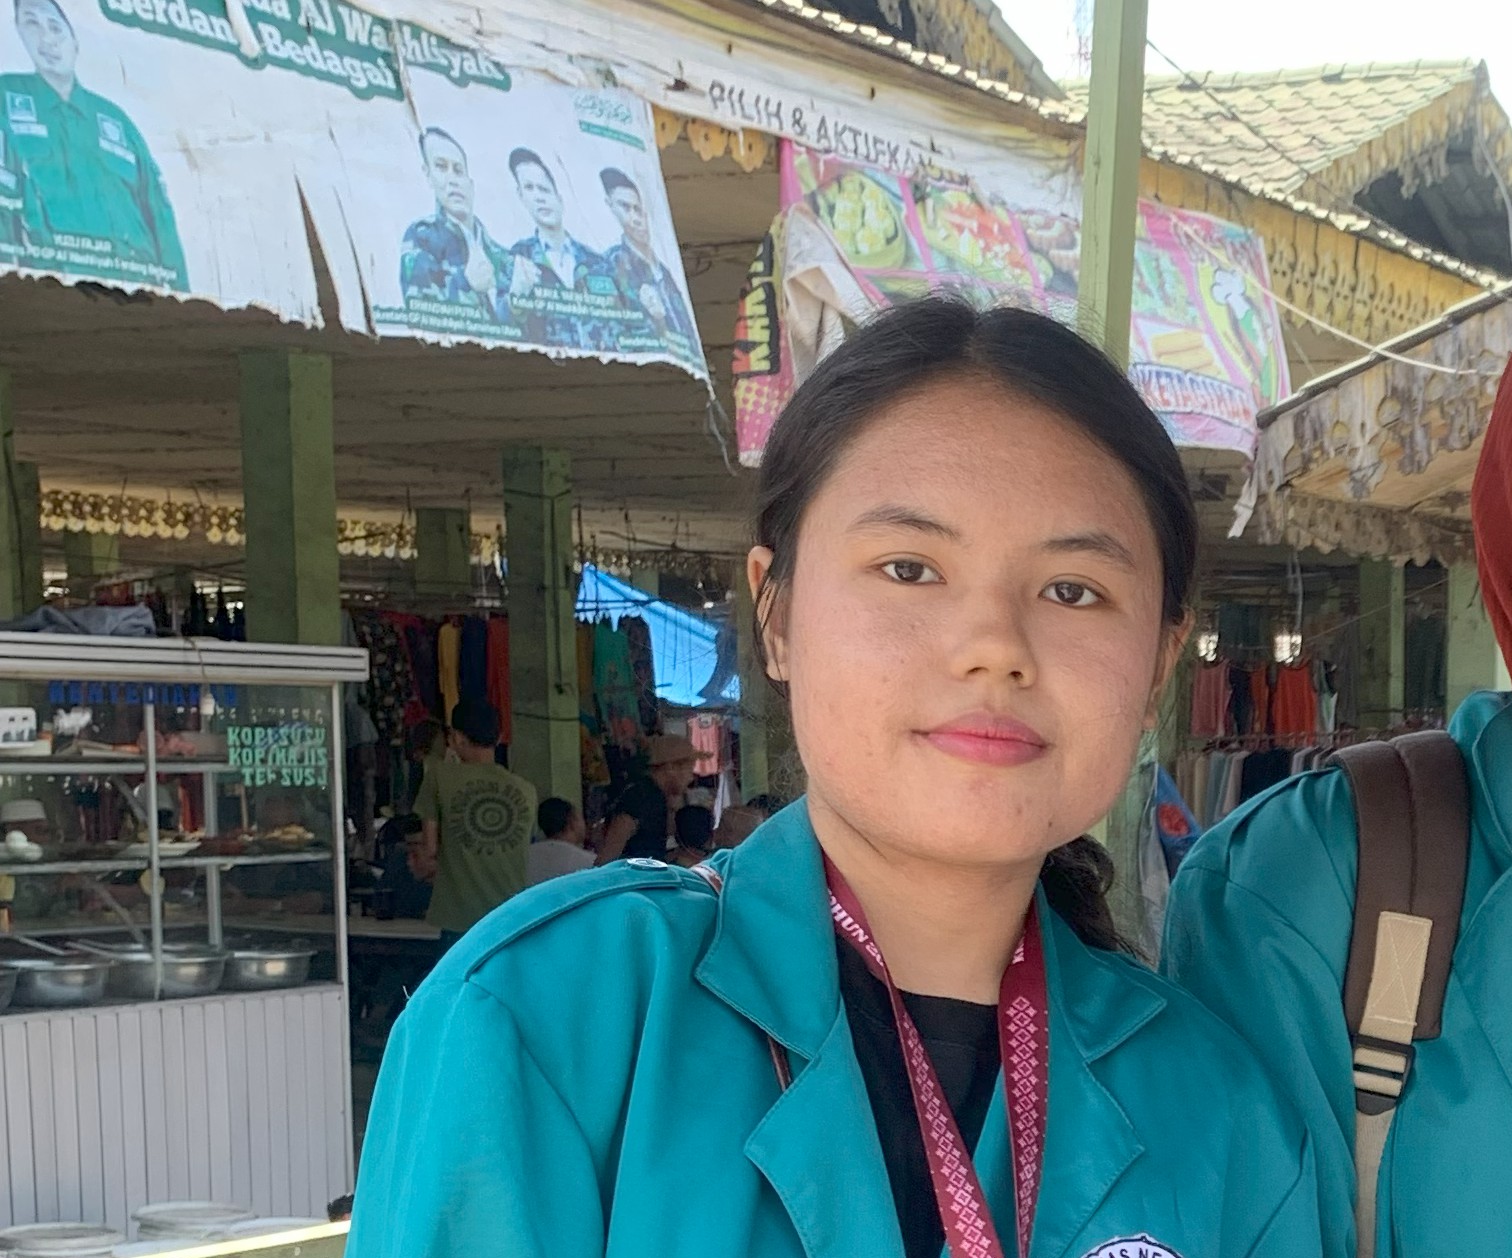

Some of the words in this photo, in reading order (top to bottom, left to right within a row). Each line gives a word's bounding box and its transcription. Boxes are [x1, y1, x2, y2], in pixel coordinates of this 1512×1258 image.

[108, 0, 238, 45] erdan
[257, 22, 397, 90] Bedagai
[337, 4, 505, 80] Wahliyah
[707, 79, 785, 131] PILIH
[790, 107, 809, 139] &
